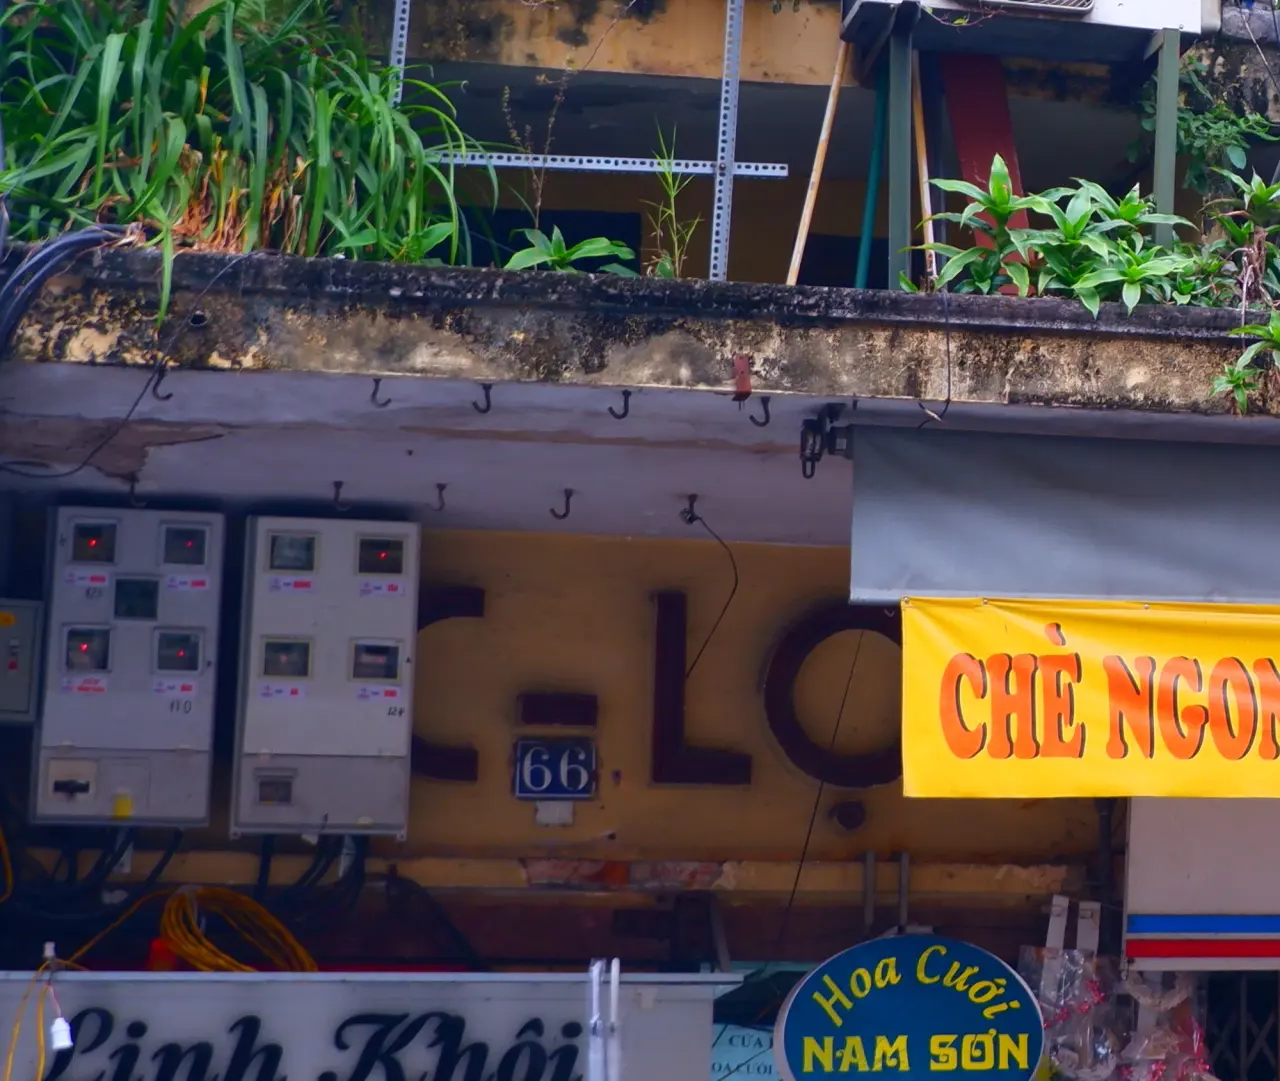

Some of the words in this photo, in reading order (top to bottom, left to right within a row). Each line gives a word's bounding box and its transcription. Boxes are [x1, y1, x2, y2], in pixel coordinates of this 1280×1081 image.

[939, 622, 1086, 759] CHÈ
[522, 746, 590, 792] 66
[812, 956, 903, 1027] Hoa
[916, 945, 1021, 1019] Cưới
[40, 1006, 288, 1081] Linh
[316, 1009, 585, 1081] Khôi
[803, 1035, 910, 1073] NAM
[929, 1027, 1030, 1072] SƠN
